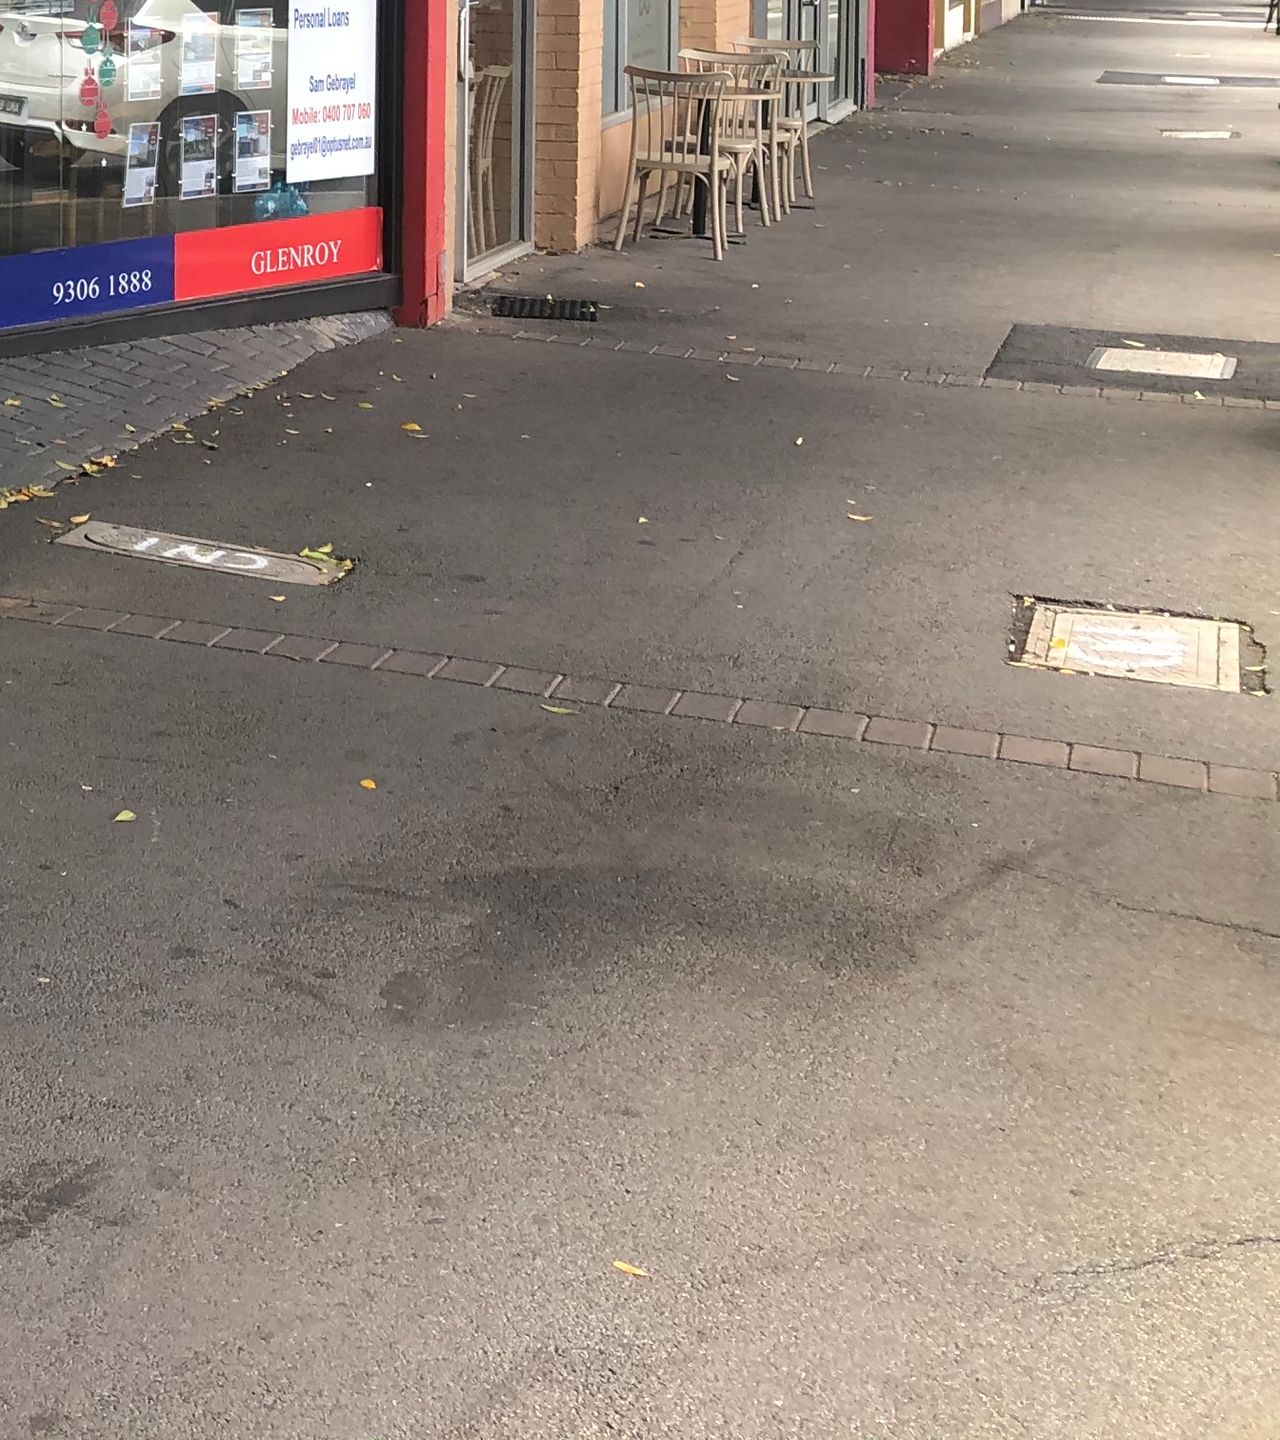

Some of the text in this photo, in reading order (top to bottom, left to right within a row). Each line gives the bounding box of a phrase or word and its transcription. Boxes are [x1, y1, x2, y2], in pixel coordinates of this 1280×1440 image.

[294, 7, 350, 29] Personal Loans
[309, 74, 325, 93] Sam
[250, 239, 343, 276] GLENROY
[52, 269, 152, 306] 9306 1888
